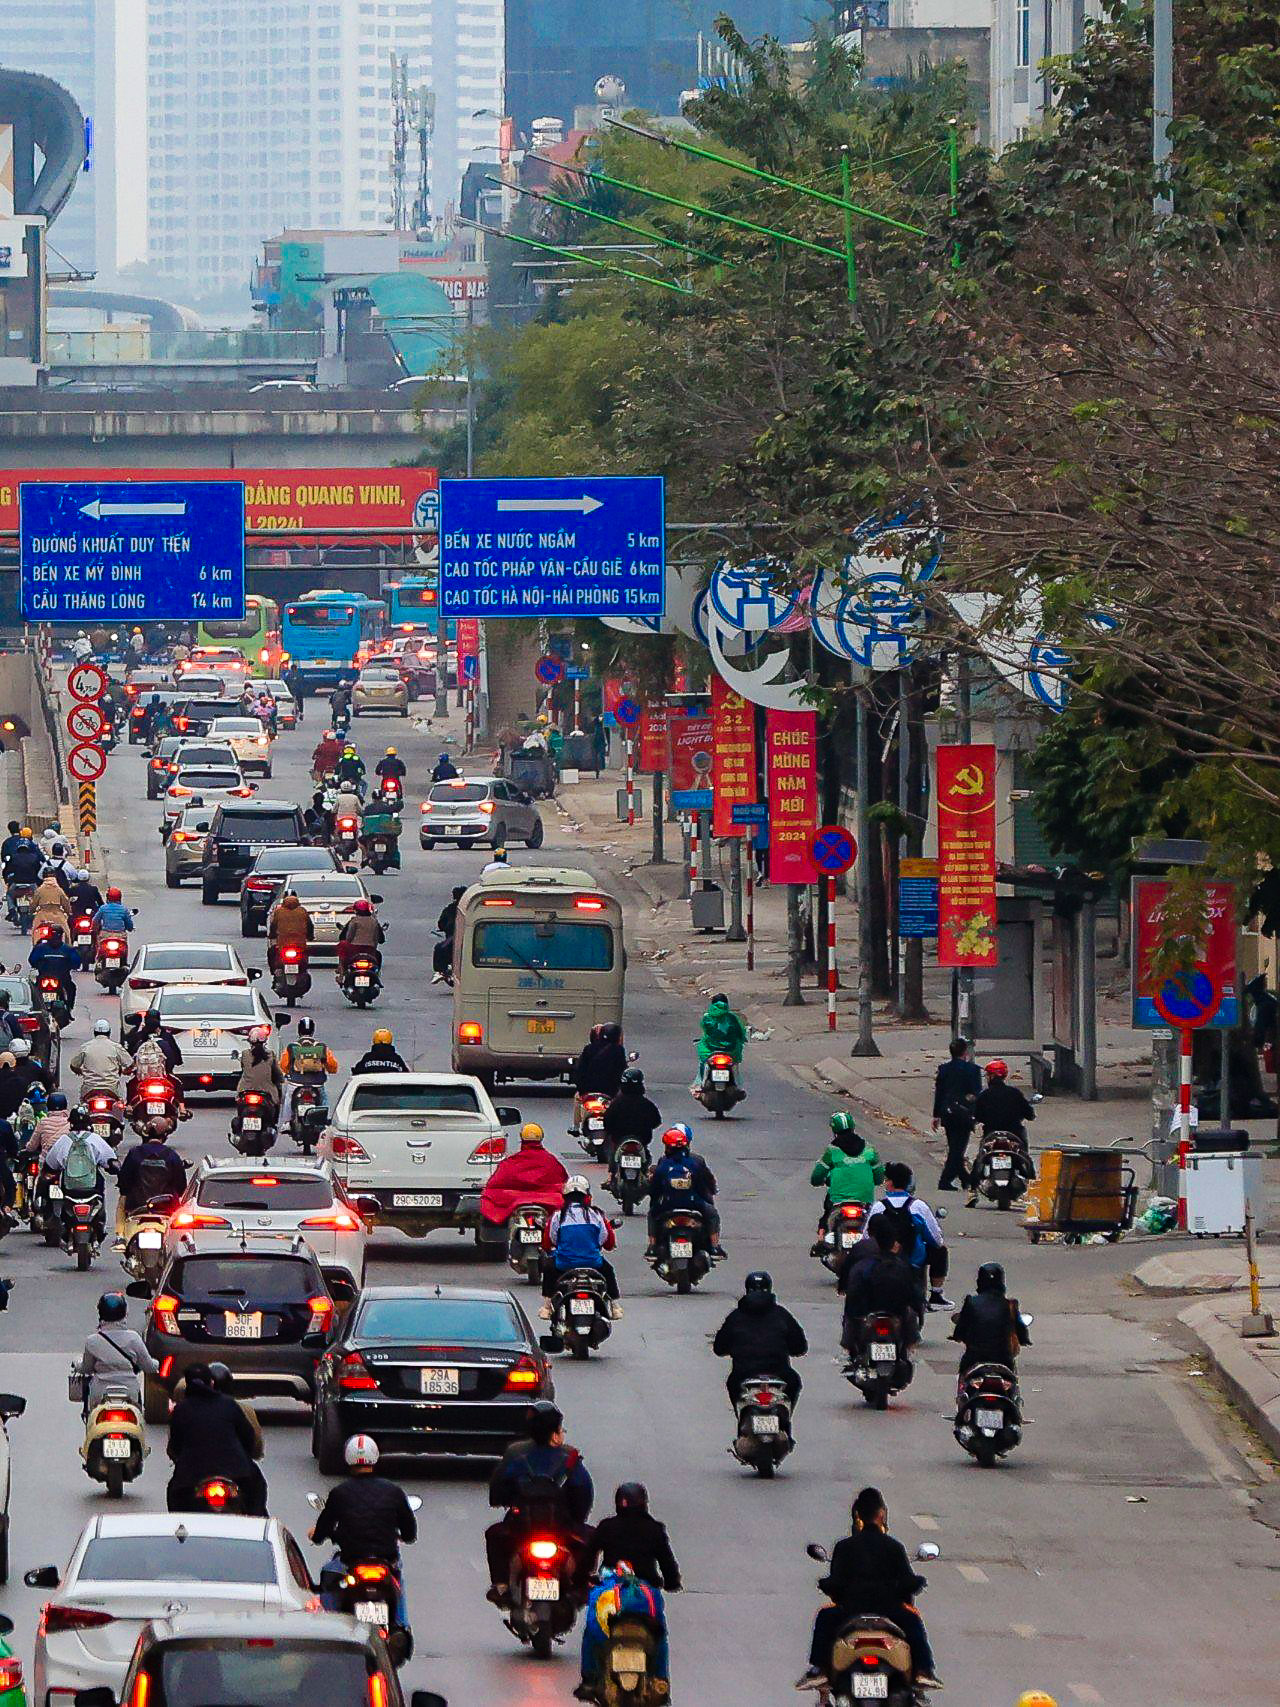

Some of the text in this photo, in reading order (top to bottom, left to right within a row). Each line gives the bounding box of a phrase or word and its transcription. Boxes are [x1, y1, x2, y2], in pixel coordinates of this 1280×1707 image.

[295, 485, 354, 508] QUANG
[130, 538, 155, 553] DUY
[444, 528, 470, 549] BẾN
[476, 534, 492, 549] XE
[497, 528, 533, 549] NƯỚC
[628, 533, 635, 548] 5
[640, 533, 660, 548] km
[33, 560, 58, 581] BẾN
[64, 566, 80, 581] XE
[199, 566, 207, 581] 6
[212, 566, 232, 581] km
[444, 562, 469, 577] CAO
[474, 556, 498, 577] TỐC
[502, 557, 535, 577] PHÁP
[630, 561, 637, 576] 6
[640, 561, 660, 576] km
[62, 591, 106, 609] THĂNG
[111, 593, 146, 609] LONG
[191, 592, 207, 609] 14
[212, 593, 232, 609] km
[444, 590, 470, 605] CAO
[474, 584, 499, 605] TỐC
[502, 585, 518, 605] HÀ
[576, 584, 619, 605] PHÒNG
[773, 729, 809, 746] CHÚC
[430, 1369, 450, 1381] 29A
